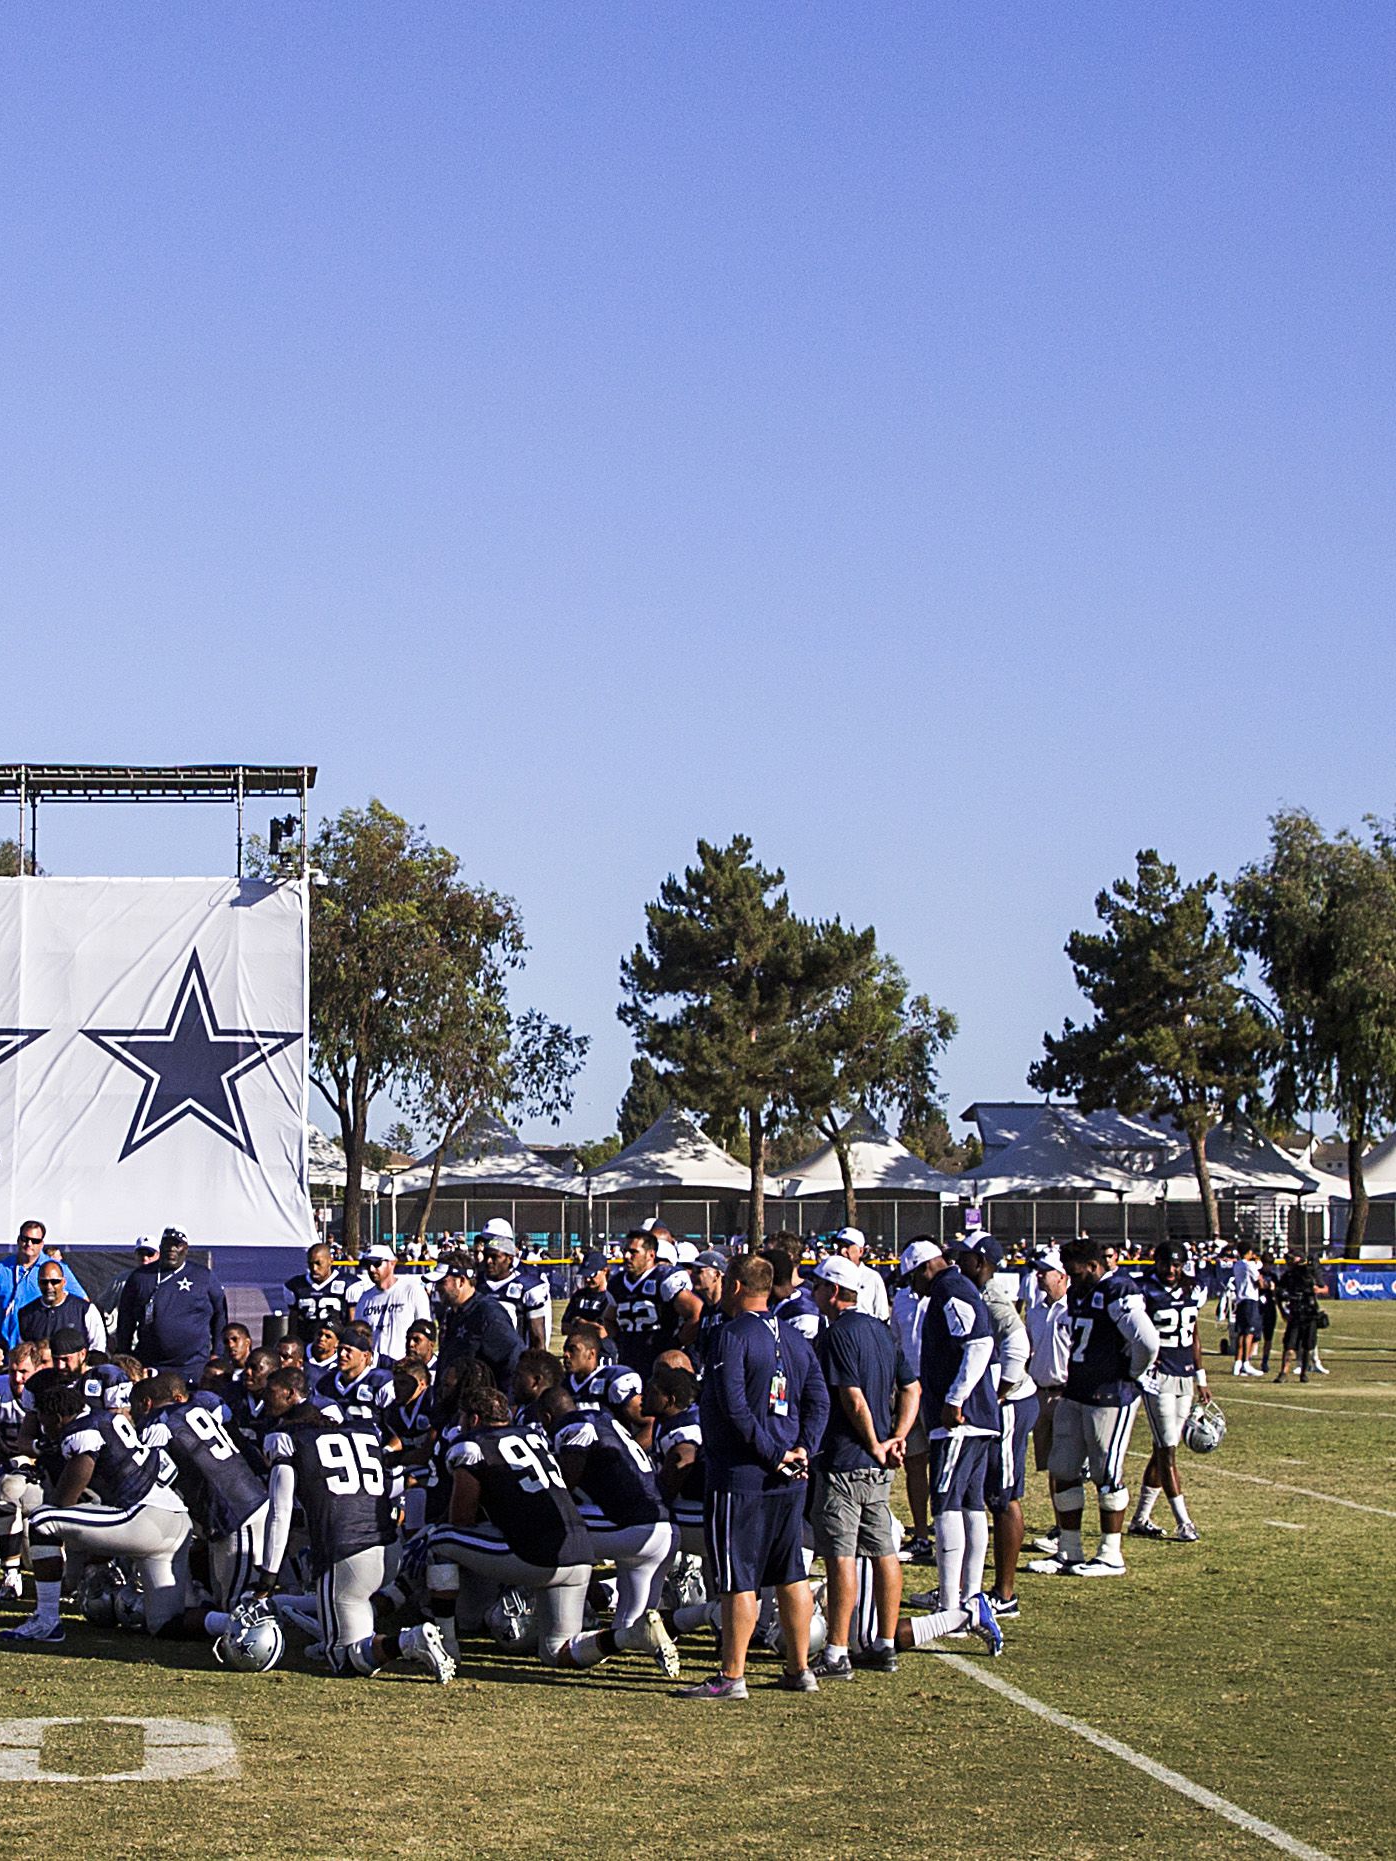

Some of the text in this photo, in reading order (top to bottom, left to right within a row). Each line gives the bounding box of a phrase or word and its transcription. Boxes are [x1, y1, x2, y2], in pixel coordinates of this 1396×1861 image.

[616, 1300, 659, 1332] 52
[1154, 1306, 1198, 1348] 28
[111, 1414, 150, 1466] 9
[186, 1407, 240, 1461] 9
[610, 1419, 653, 1474] 6
[315, 1433, 385, 1496] 95
